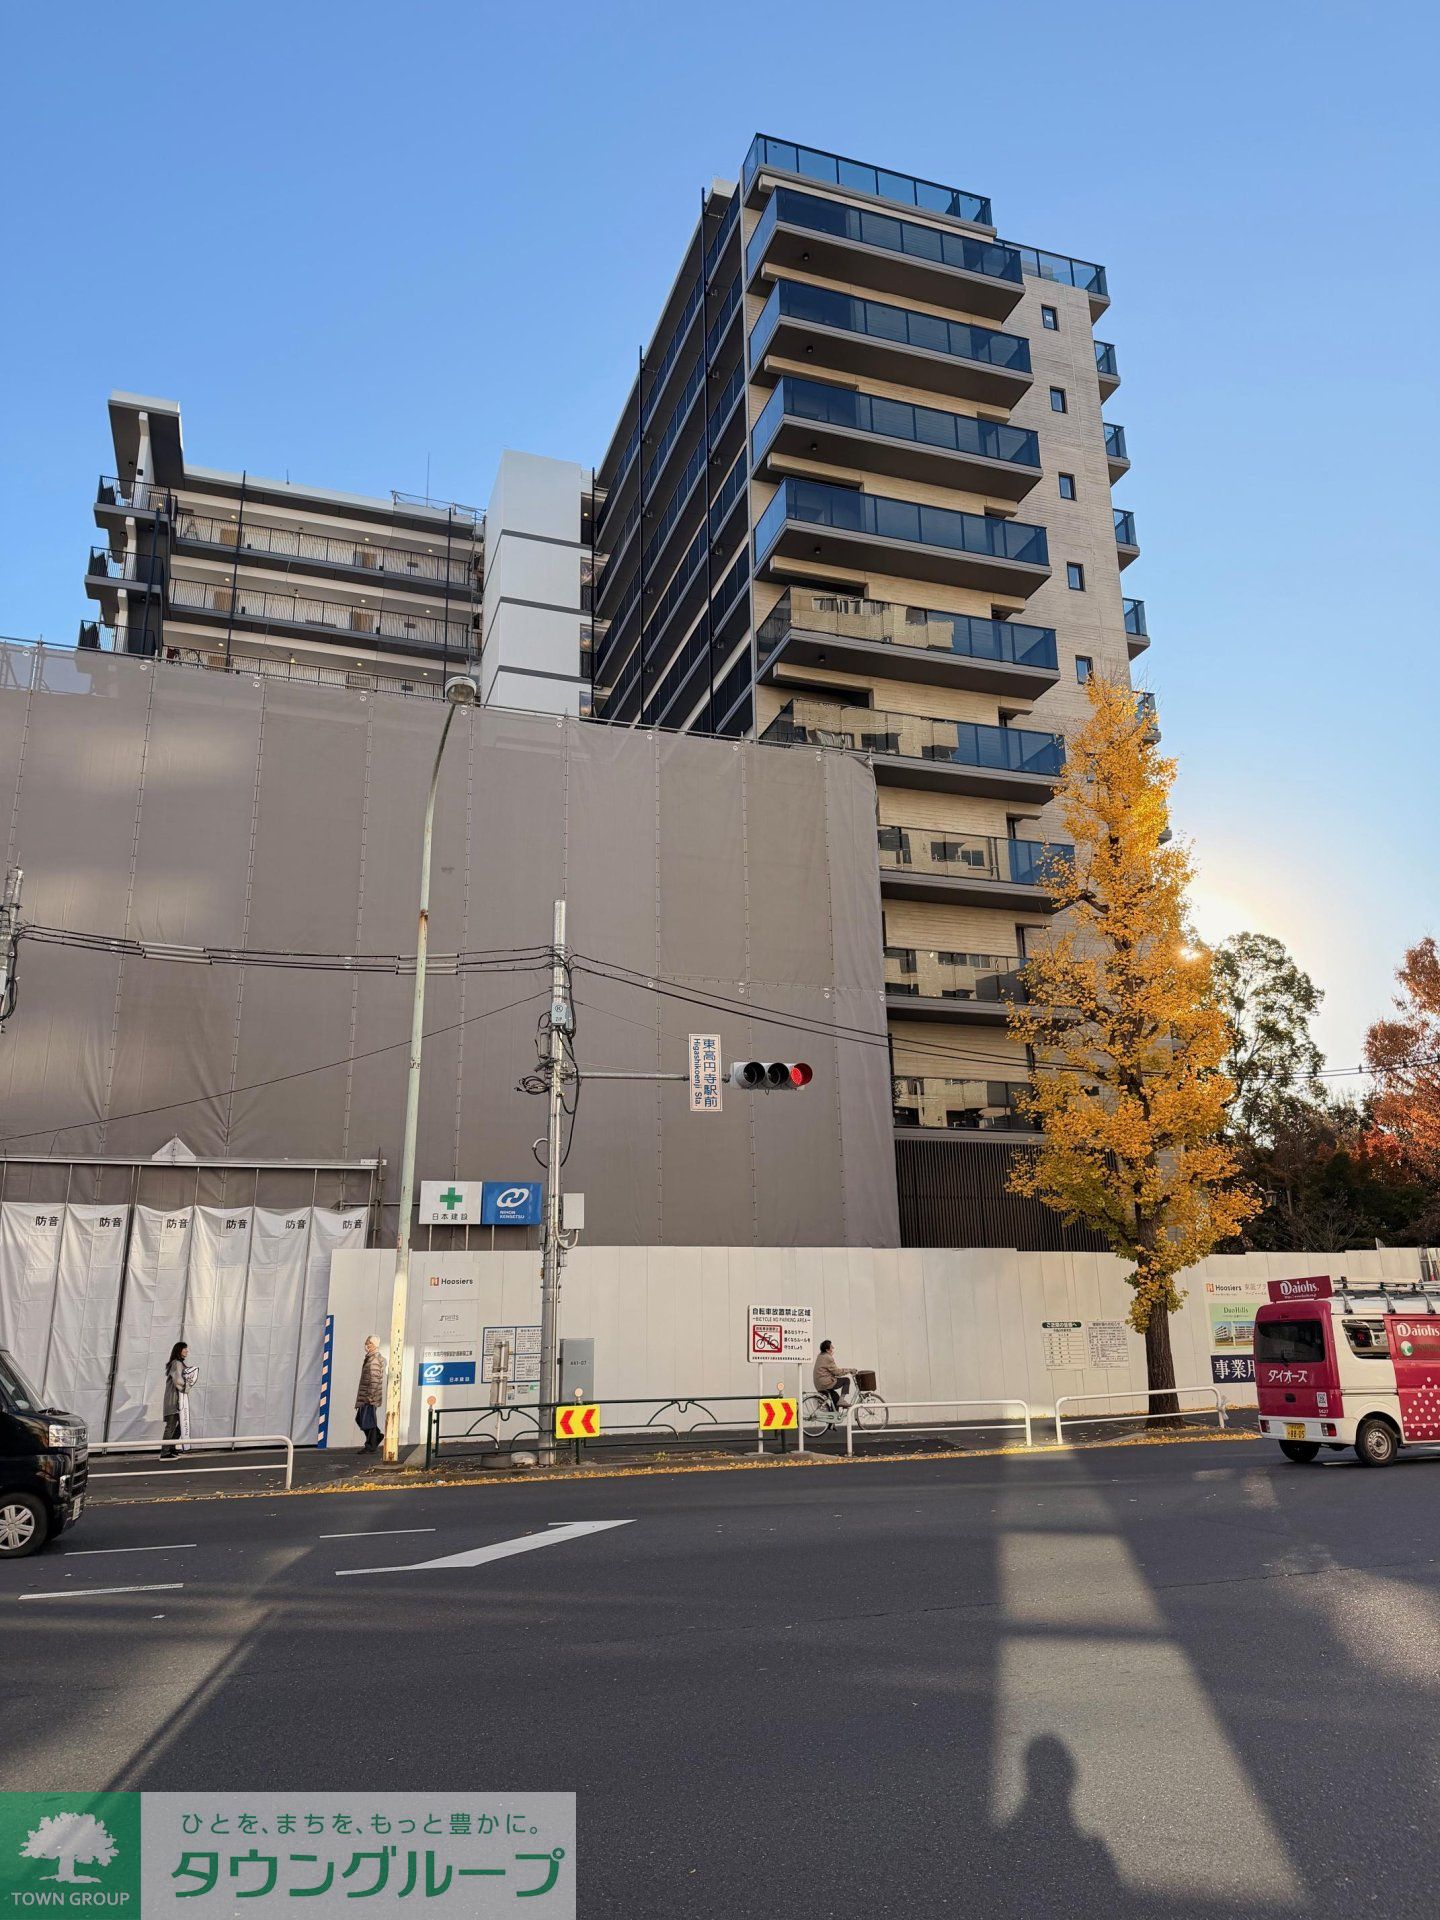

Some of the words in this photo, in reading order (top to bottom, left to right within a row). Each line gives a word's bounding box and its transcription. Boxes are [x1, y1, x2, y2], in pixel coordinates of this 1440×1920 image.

[693, 1038, 702, 1088] Higashikoenji
[703, 1038, 718, 1108] 東高円寺駅前
[694, 1092, 702, 1106] Sta.
[35, 1216, 59, 1227] 防音
[99, 1217, 122, 1228] 防音
[432, 1213, 468, 1221] 日本建設
[166, 1218, 189, 1229] 防音
[226, 1219, 248, 1229] 防音
[285, 1219, 307, 1229] 防音
[342, 1219, 363, 1230] 防音
[1280, 1280, 1318, 1295] Daiohs
[752, 1308, 811, 1316] 自転車放置禁止区域
[1397, 1323, 1440, 1337] Daiohs
[1268, 1370, 1308, 1383] ダイオーズ
